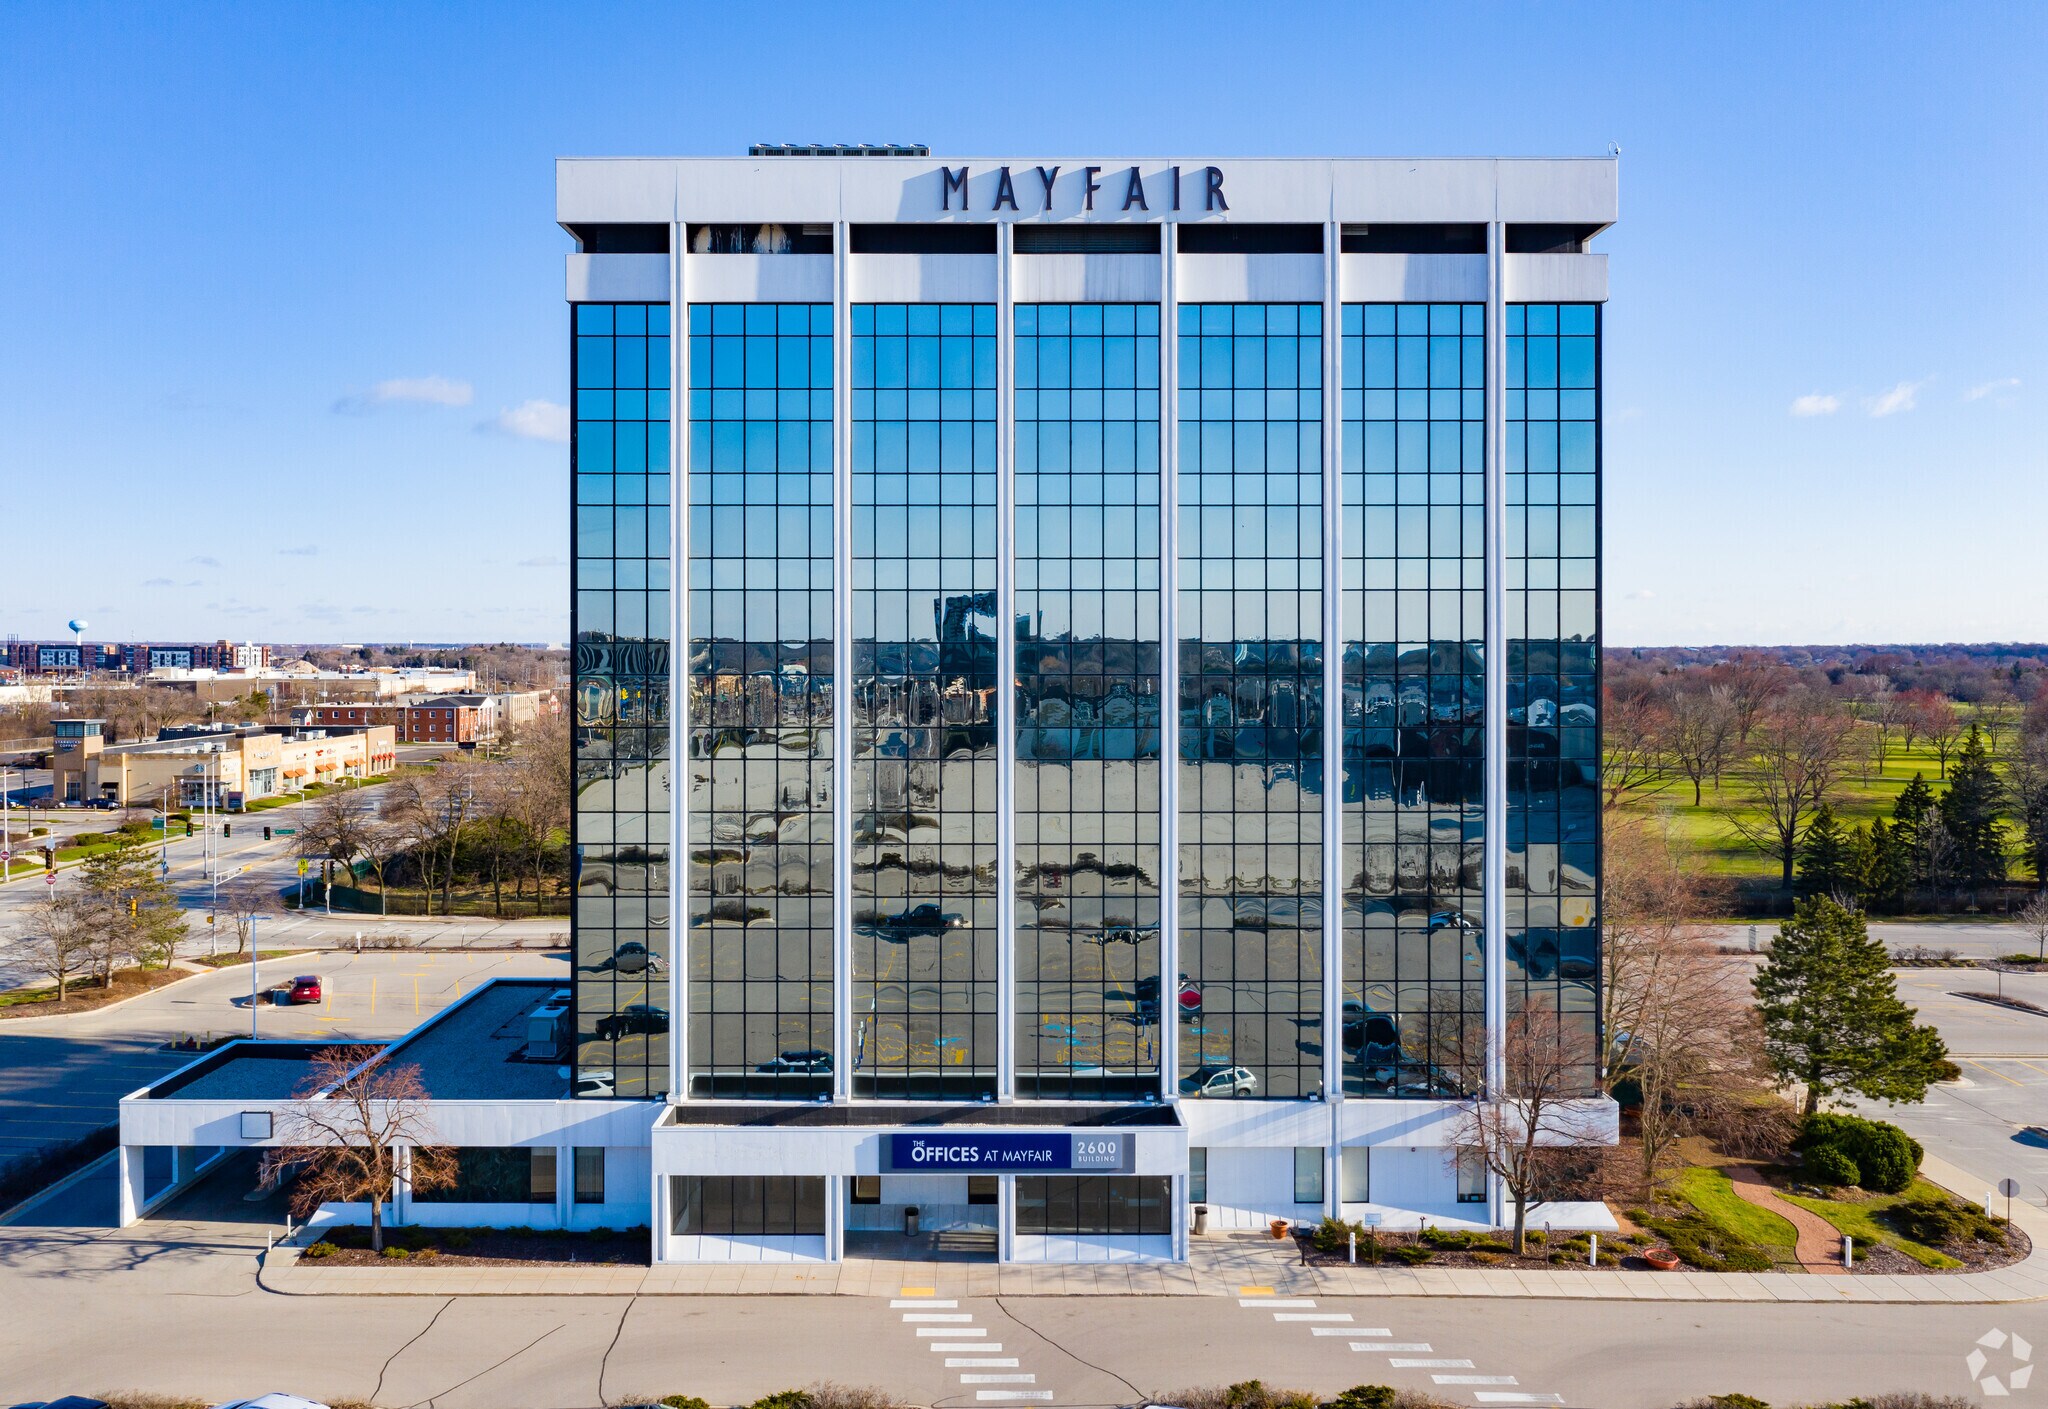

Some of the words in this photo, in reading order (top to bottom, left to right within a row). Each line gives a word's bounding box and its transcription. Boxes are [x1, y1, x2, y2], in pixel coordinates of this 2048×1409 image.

[942, 166, 1230, 211] MAYFAIR
[911, 1146, 979, 1162] OFFICES
[984, 1150, 998, 1162] AT
[1002, 1150, 1053, 1162] MAYFAIR
[1077, 1142, 1116, 1154] 2600
